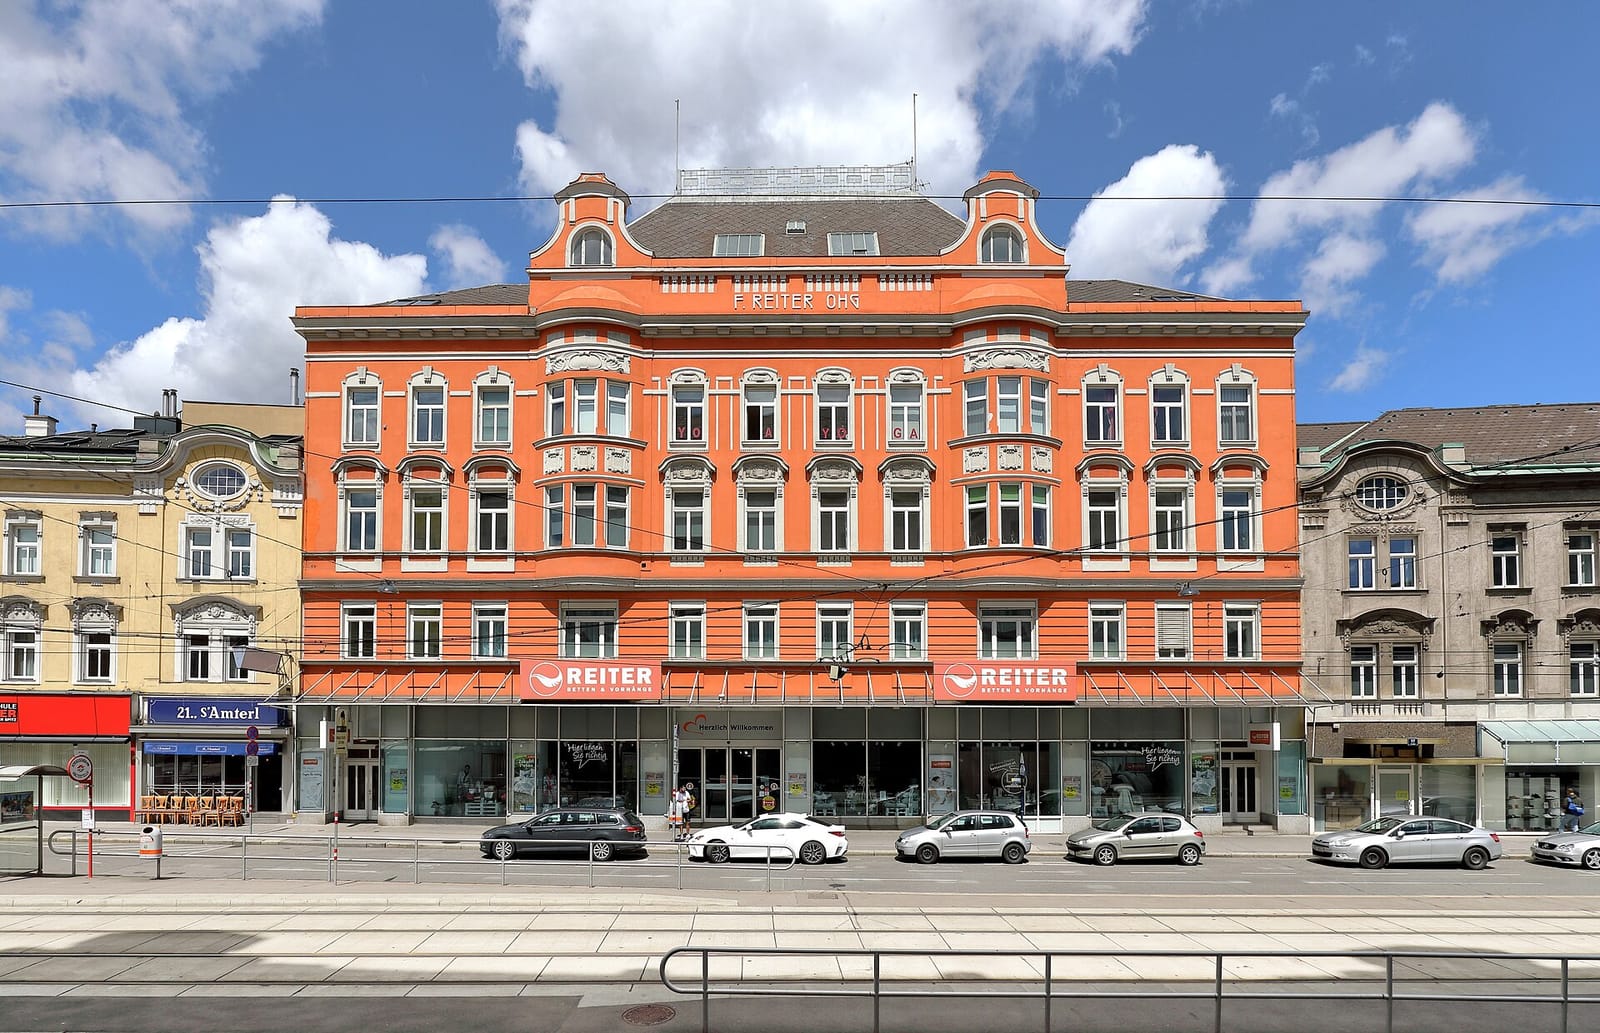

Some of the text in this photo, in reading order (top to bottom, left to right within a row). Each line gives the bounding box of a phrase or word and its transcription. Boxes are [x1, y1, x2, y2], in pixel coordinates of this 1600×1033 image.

[734, 294, 860, 309] F. REITER OHG
[567, 667, 652, 685] REITER
[981, 668, 1068, 686] REITER
[572, 751, 584, 760] Sie
[1146, 753, 1180, 766] Sie richtig
